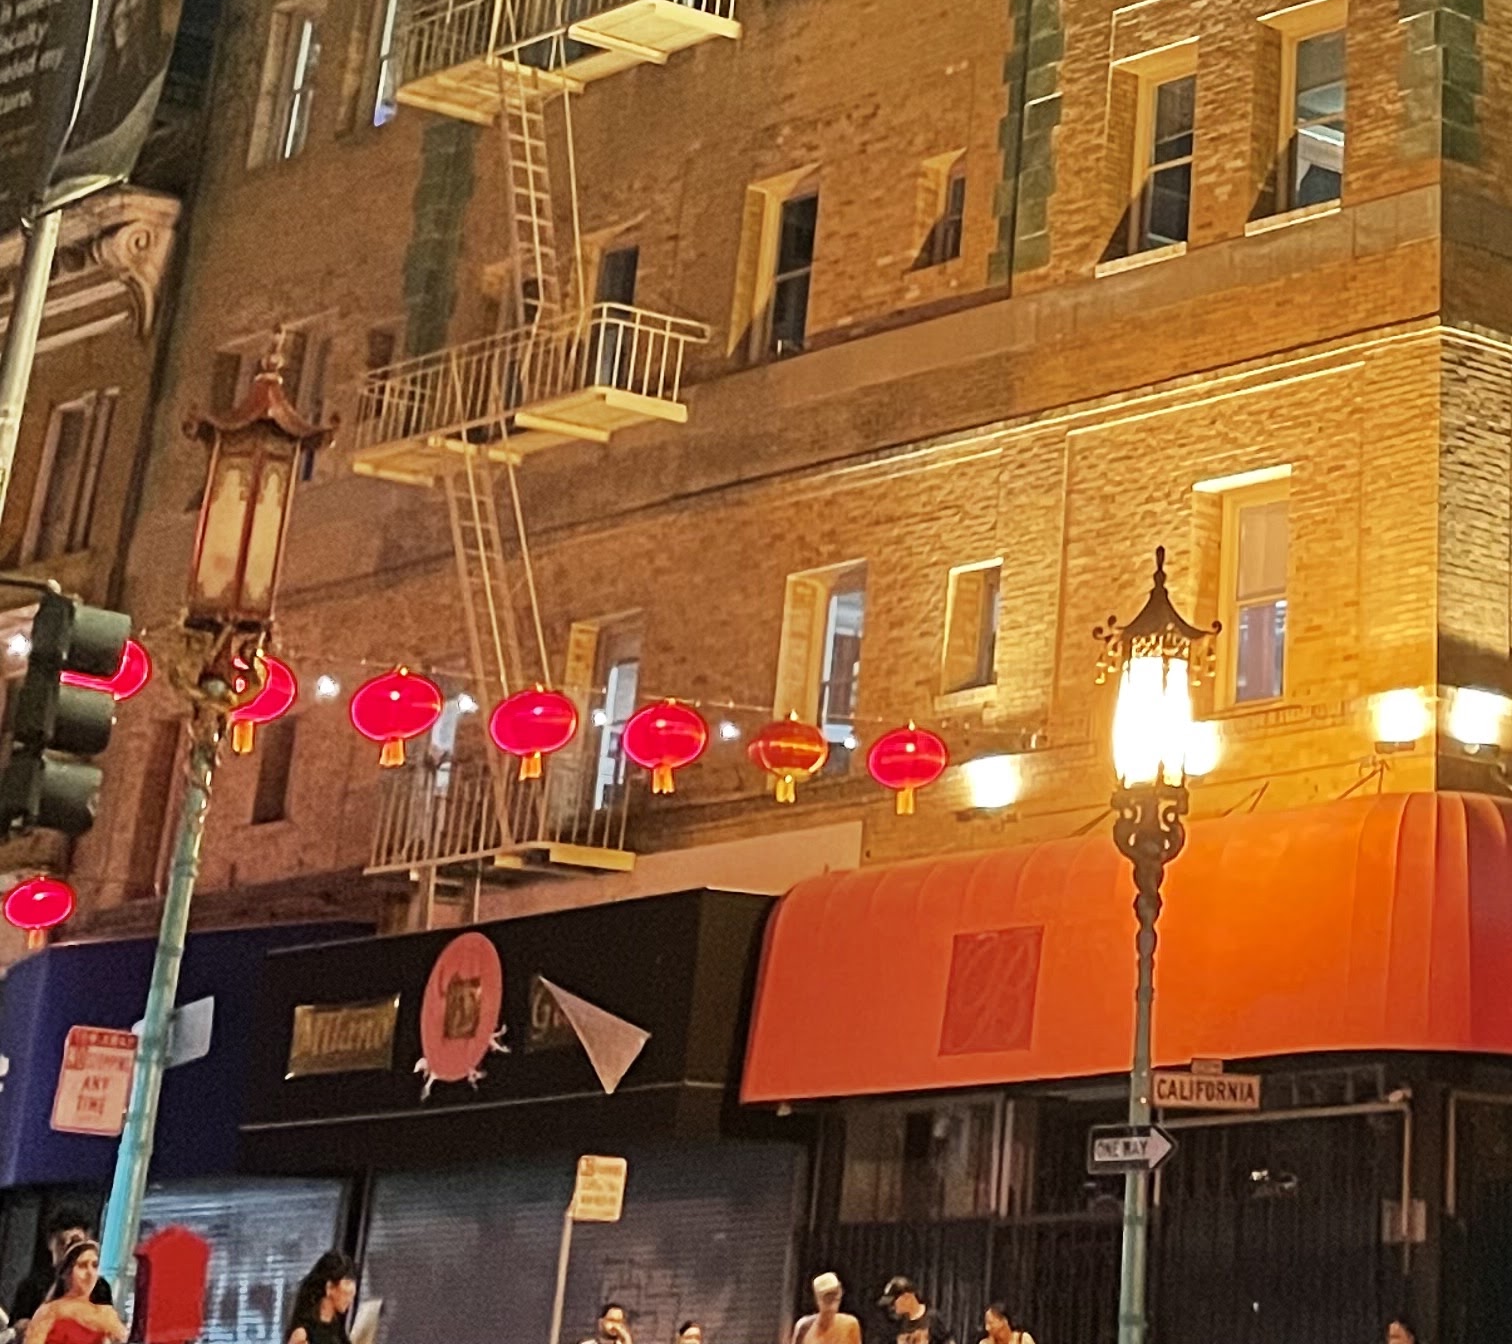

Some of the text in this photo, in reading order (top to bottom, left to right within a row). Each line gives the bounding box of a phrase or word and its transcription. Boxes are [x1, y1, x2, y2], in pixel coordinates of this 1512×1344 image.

[83, 1076, 111, 1090] ANY
[1156, 1079, 1256, 1102] CALIFORNIA
[1098, 1136, 1148, 1159] ONE WAY
